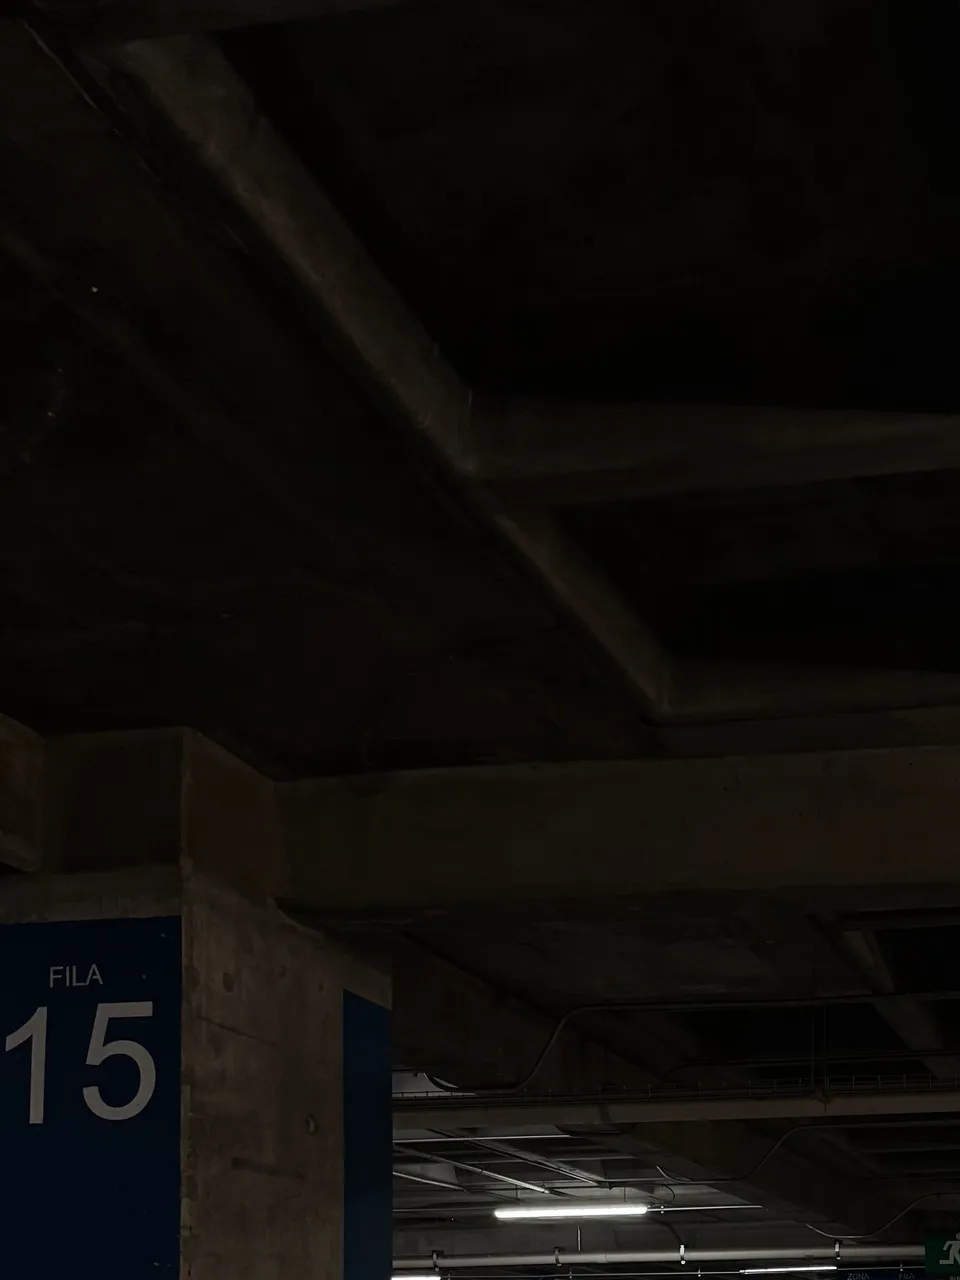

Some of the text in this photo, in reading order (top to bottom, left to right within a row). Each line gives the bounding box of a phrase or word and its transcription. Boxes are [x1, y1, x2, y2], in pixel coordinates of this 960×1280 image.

[48, 965, 104, 988] FILA
[4, 1001, 157, 1126] 15
[847, 1273, 916, 1280] ZONA FILA
